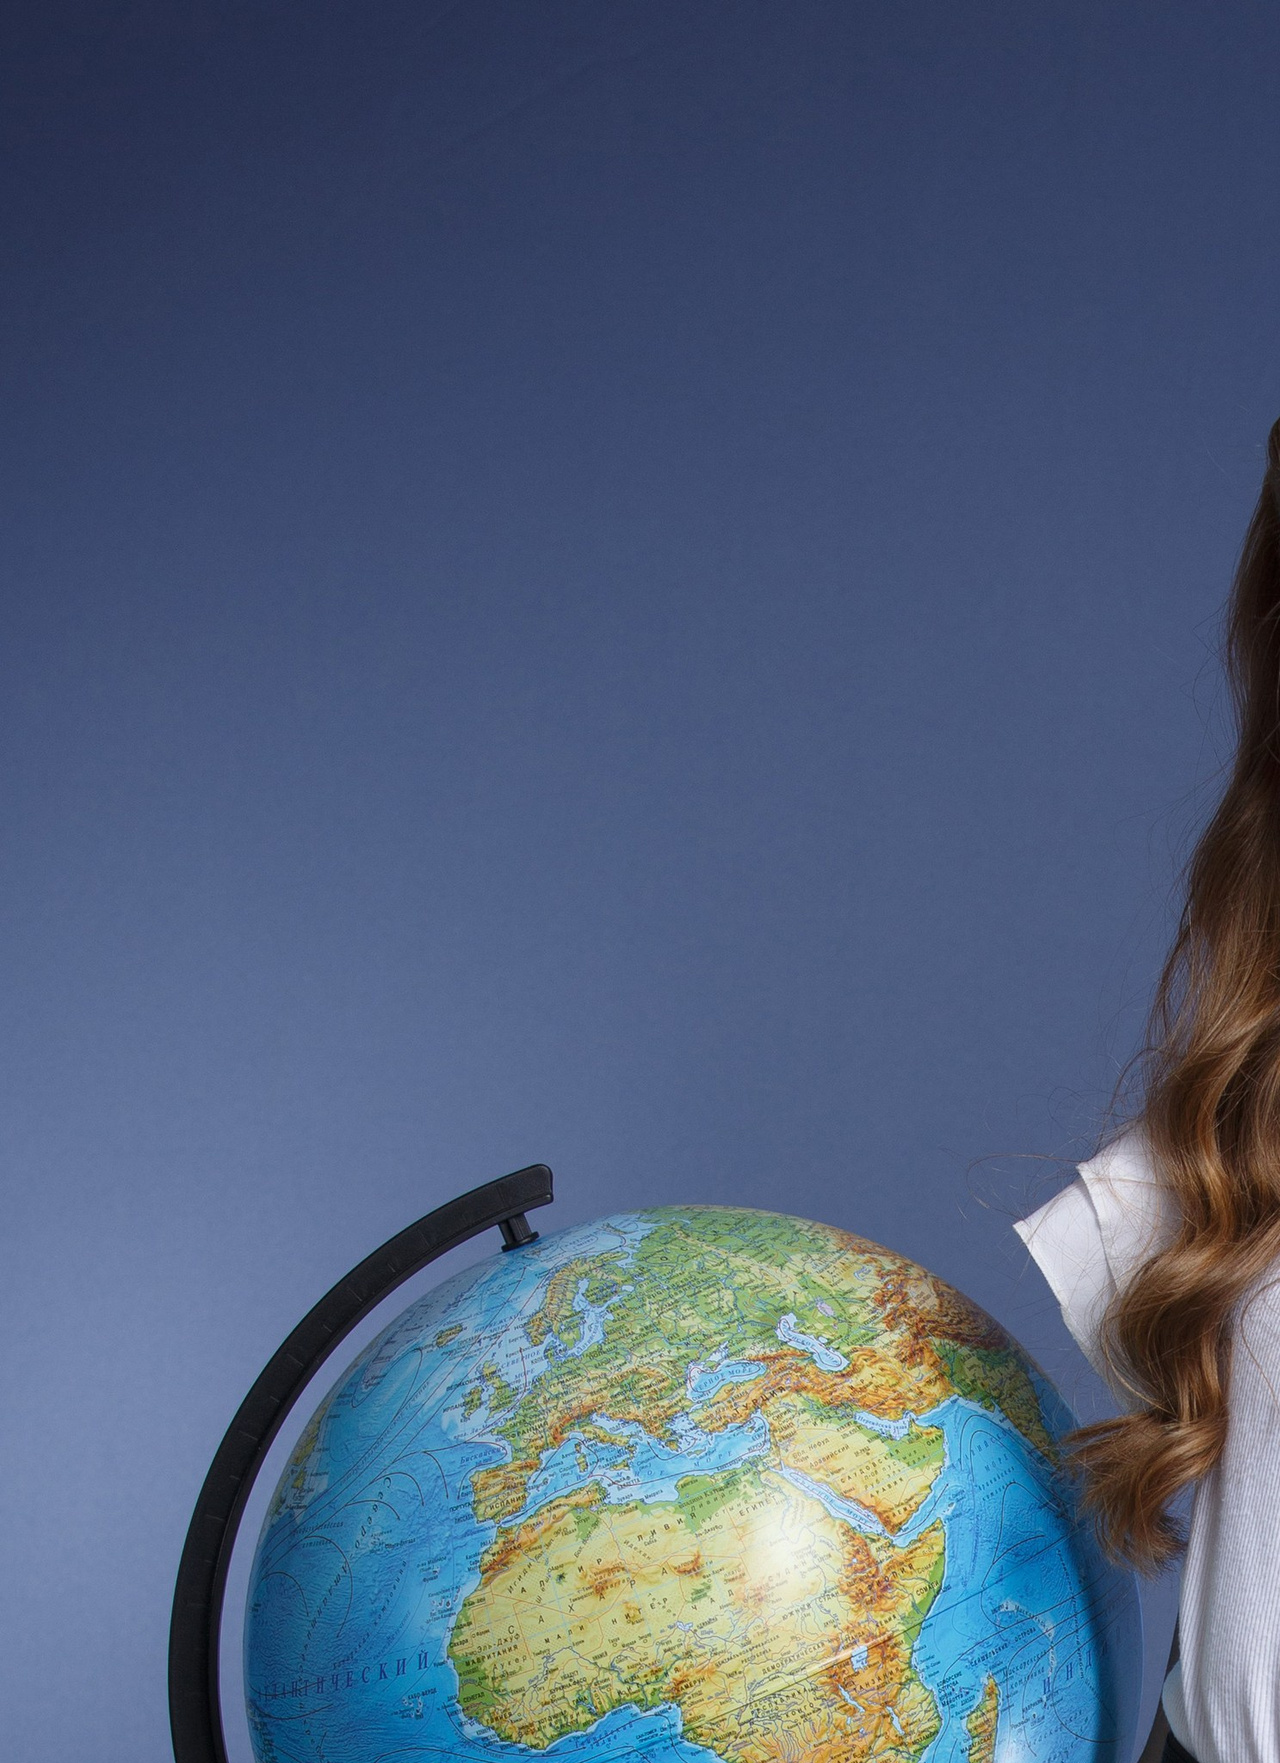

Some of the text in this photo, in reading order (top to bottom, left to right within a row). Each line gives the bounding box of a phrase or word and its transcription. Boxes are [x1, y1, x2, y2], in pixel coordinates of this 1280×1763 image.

[733, 1385, 787, 1417] ТУРЦИЯ
[489, 1494, 527, 1511] ИСПАНИЯ
[740, 1496, 777, 1517] ЕГИПЕТ
[637, 1511, 697, 1542] ЛИВИЯ
[691, 1589, 735, 1612] ЧАД
[544, 1624, 585, 1645] МАЛИ
[465, 1644, 519, 1667] МАВРИТАНИЯ
